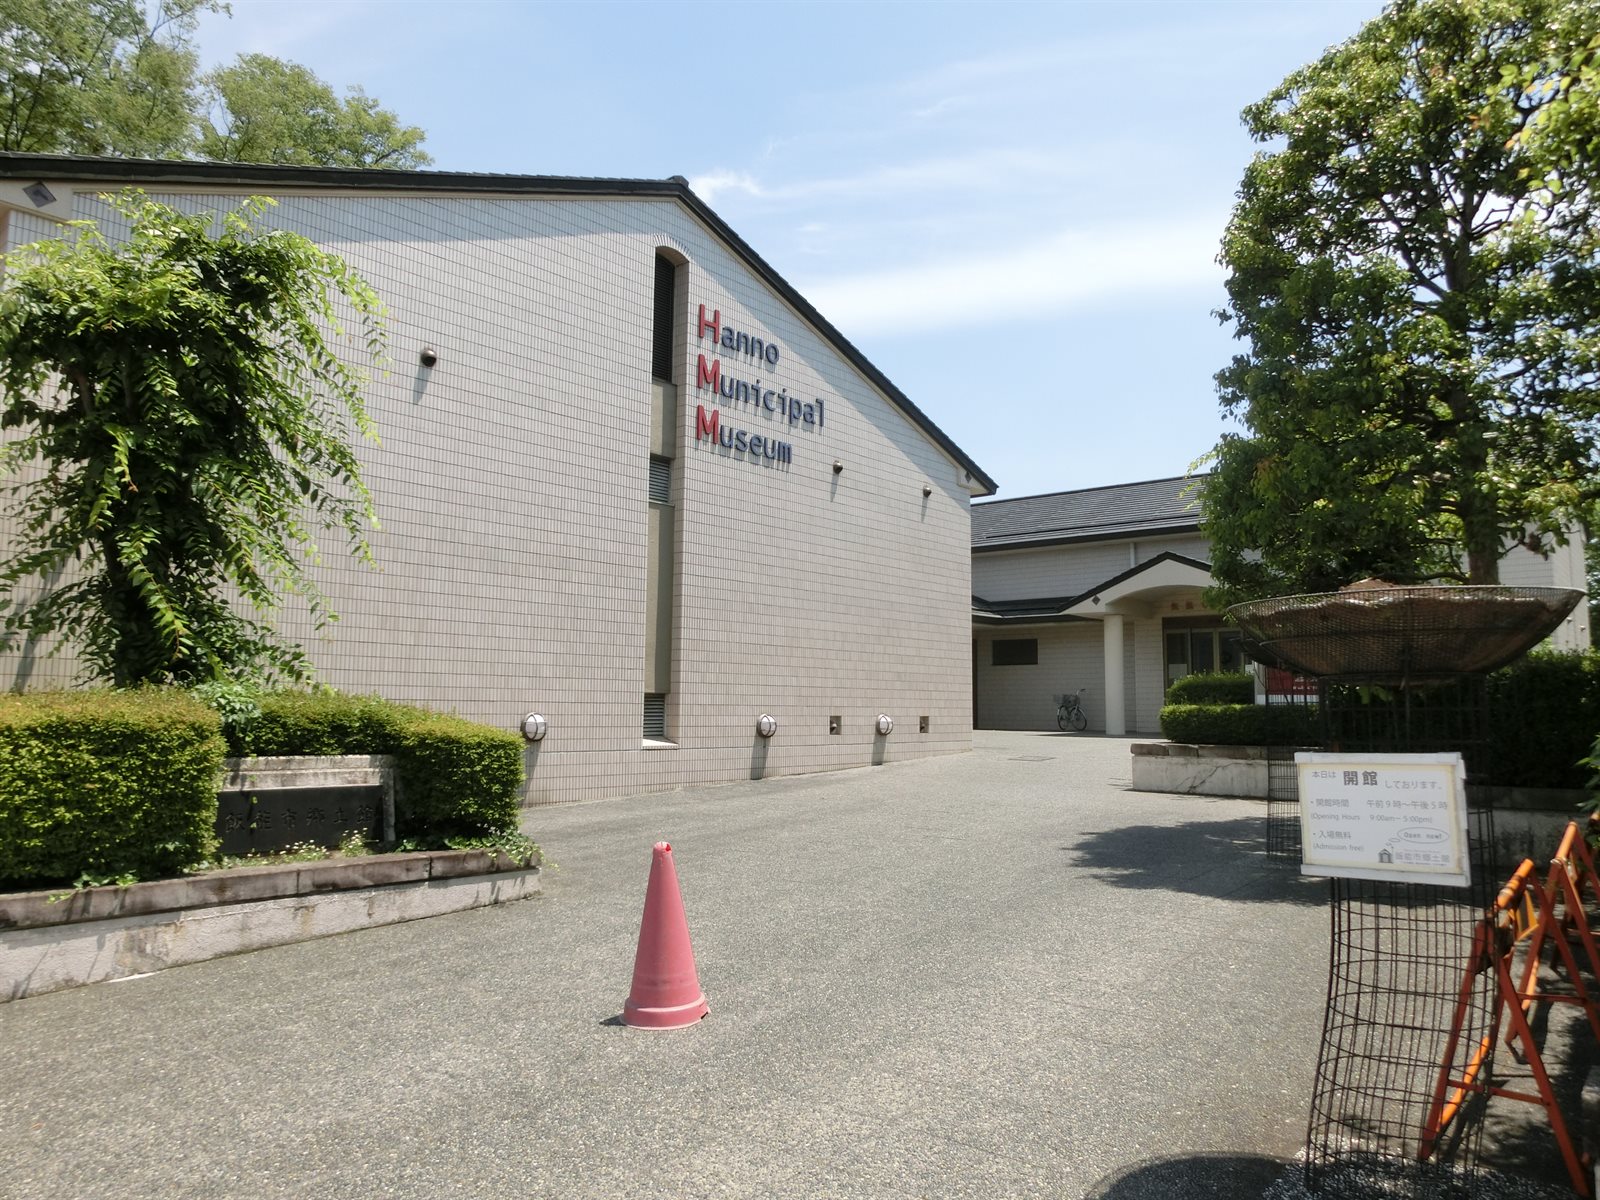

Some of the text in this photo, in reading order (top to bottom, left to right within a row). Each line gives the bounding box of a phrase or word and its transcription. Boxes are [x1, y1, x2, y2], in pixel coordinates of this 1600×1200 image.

[699, 304, 780, 365] Hanno
[698, 354, 825, 427] Municipal
[697, 405, 792, 464] Museum
[1312, 771, 1337, 779] 本日は
[1343, 770, 1378, 786] 開館
